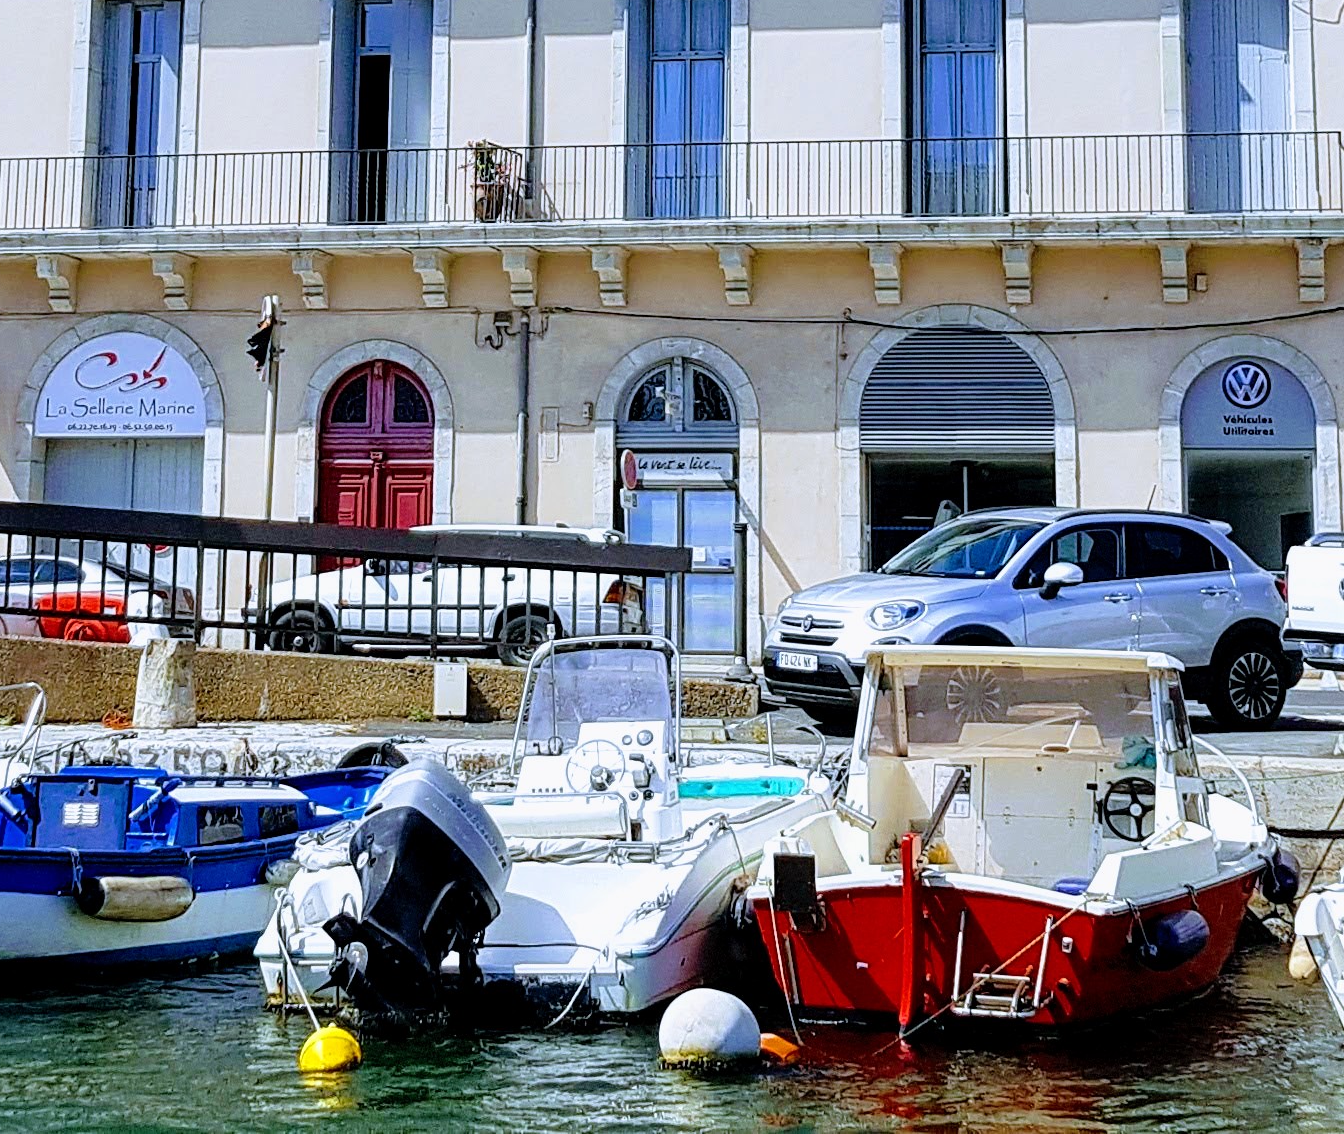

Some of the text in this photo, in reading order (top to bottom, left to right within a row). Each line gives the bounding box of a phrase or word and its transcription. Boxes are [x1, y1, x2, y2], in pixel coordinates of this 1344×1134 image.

[46, 397, 195, 417] La Sellerie Marine
[1223, 414, 1273, 424] Véhicules
[1223, 426, 1274, 436] Utilitaires
